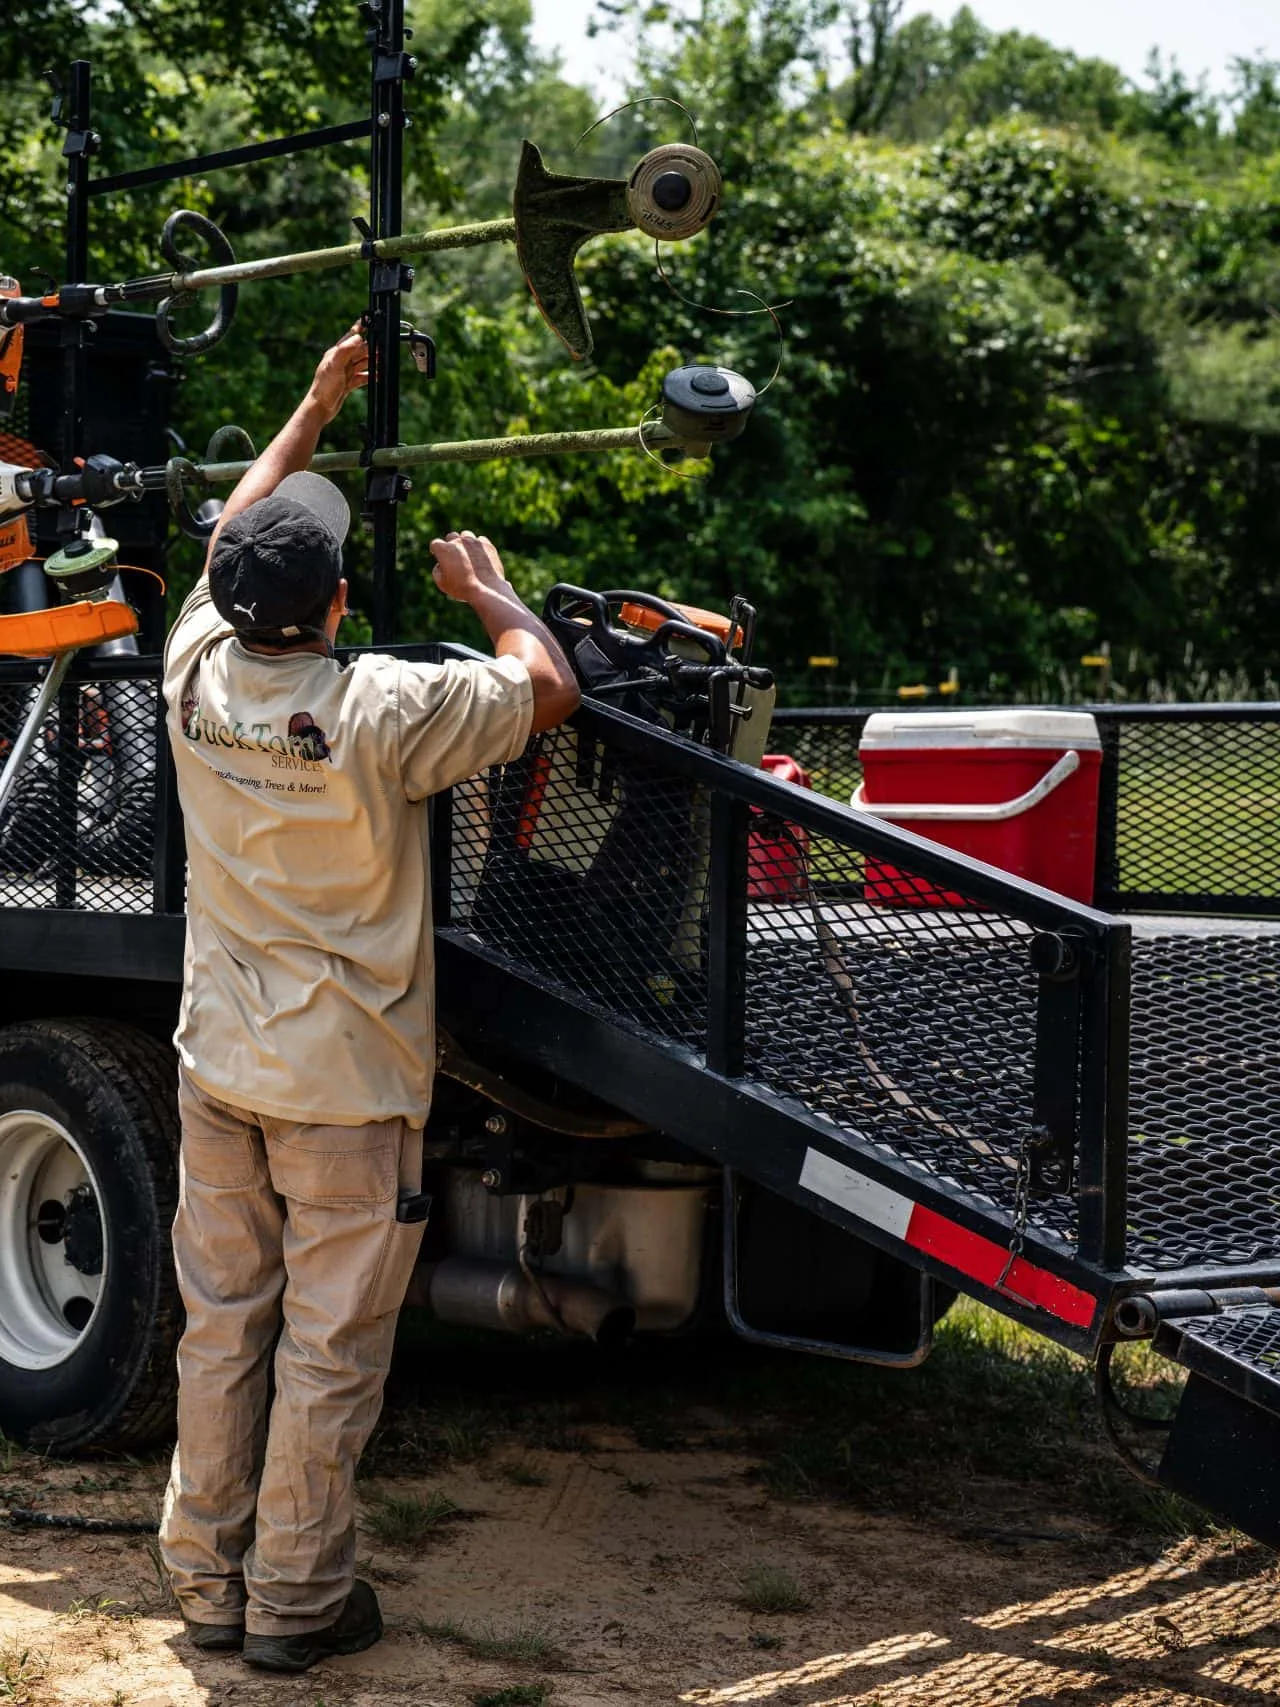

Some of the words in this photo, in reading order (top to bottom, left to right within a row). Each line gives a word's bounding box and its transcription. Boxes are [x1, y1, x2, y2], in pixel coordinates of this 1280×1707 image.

[264, 778, 285, 791] Trees
[287, 781, 296, 792] &
[298, 783, 327, 793] More!
